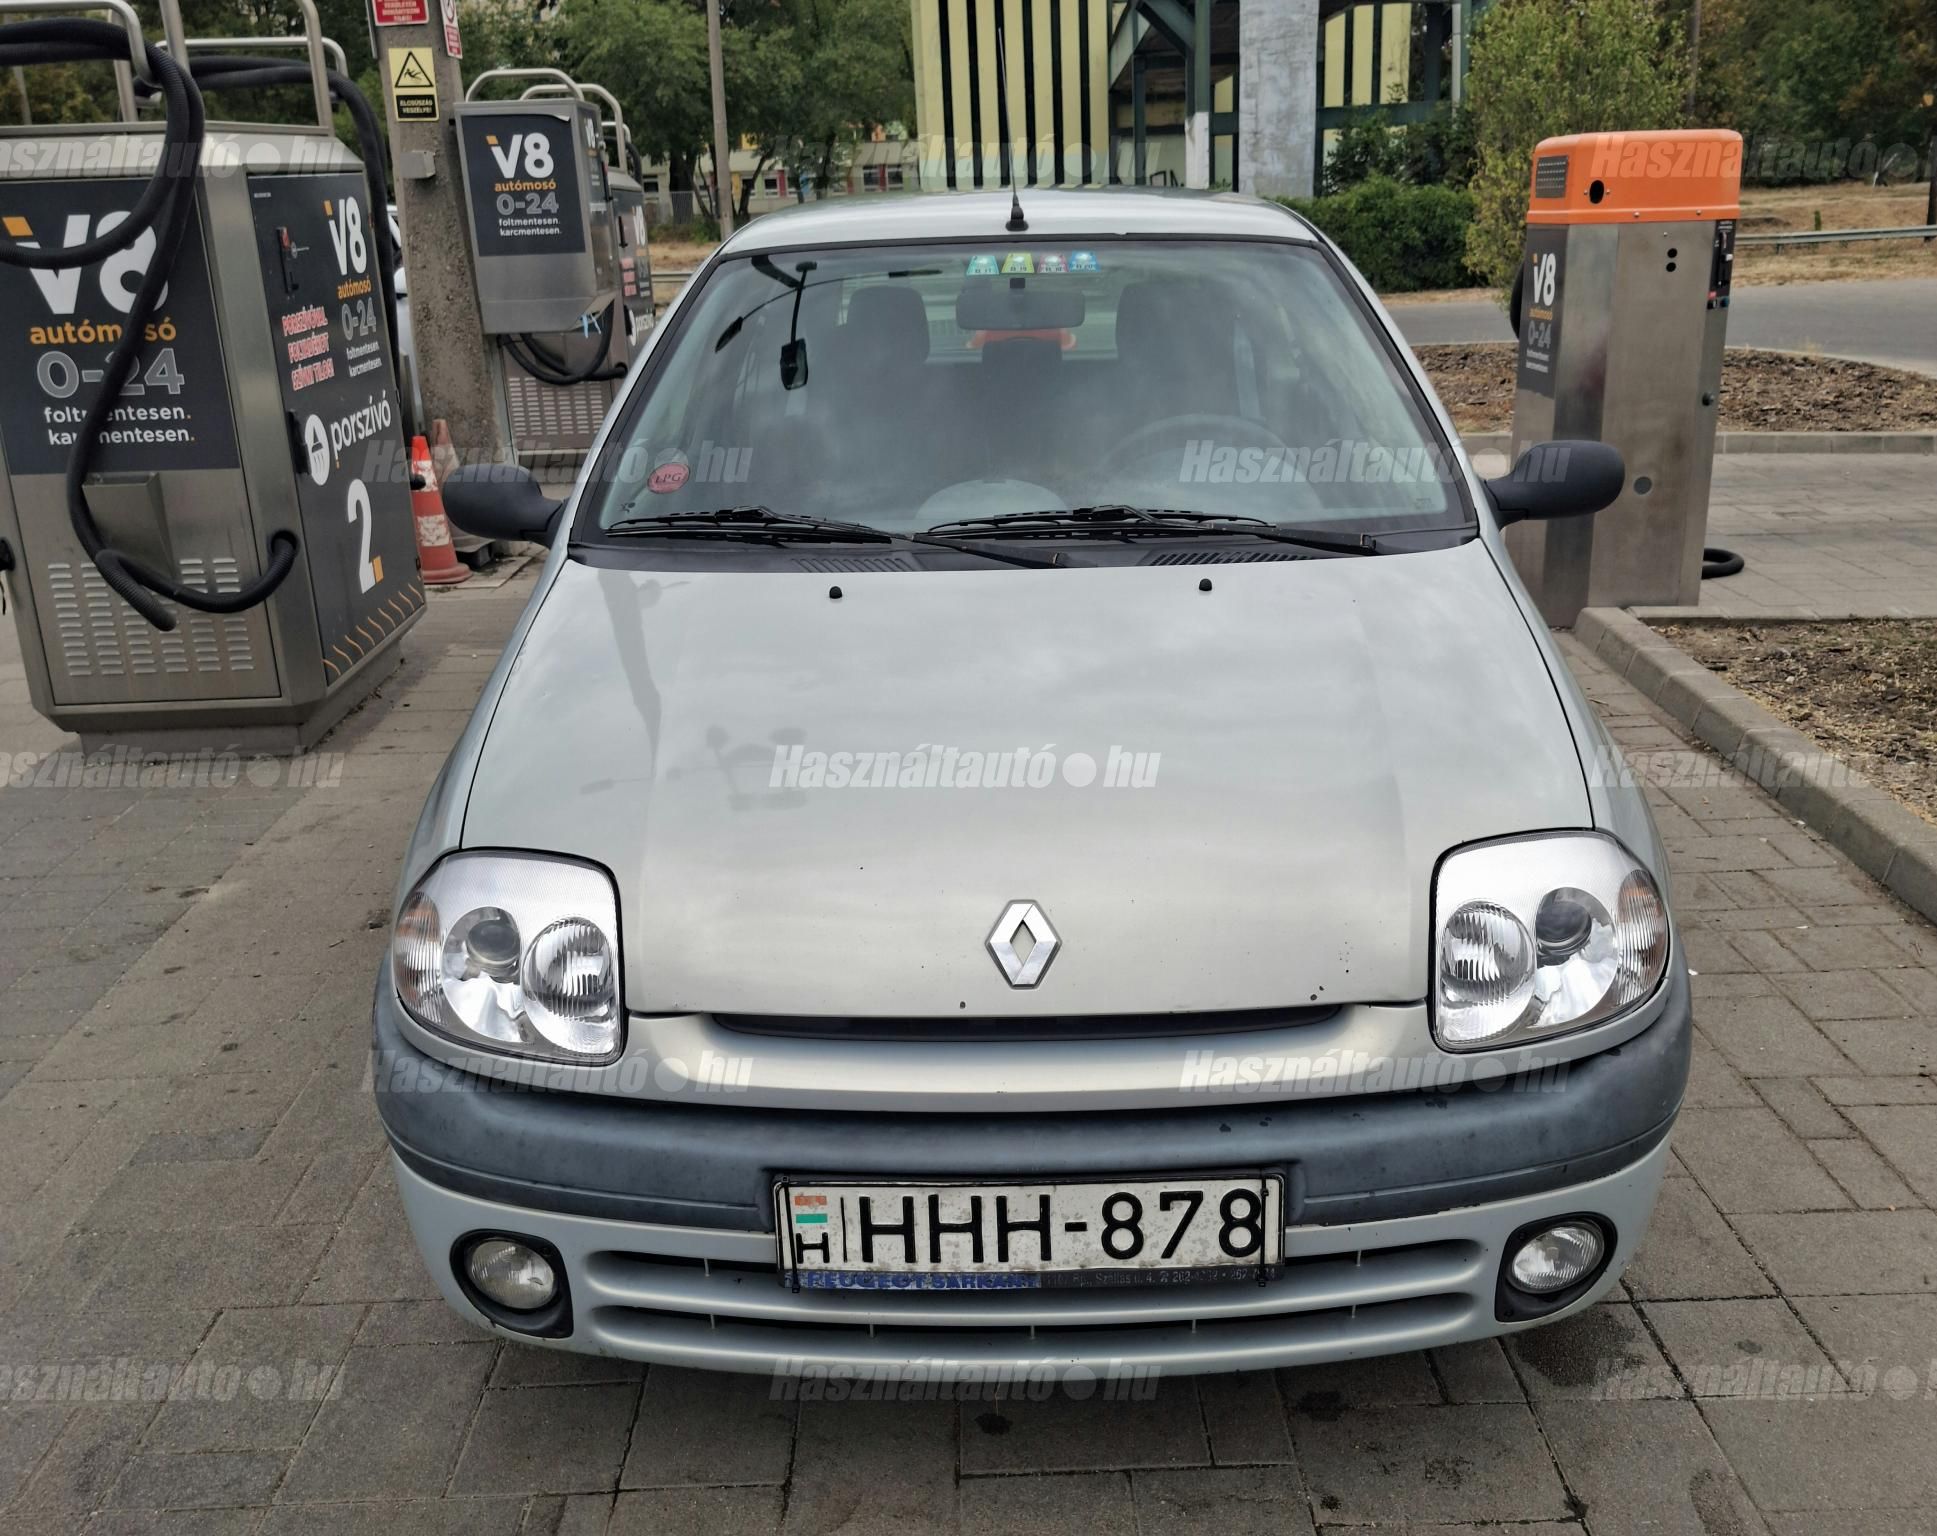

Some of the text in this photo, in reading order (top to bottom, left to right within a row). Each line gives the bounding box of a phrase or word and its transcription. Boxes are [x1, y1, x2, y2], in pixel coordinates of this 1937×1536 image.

[489, 132, 555, 179] V8
[494, 180, 557, 193] autómosó
[496, 193, 559, 217] 0-24
[328, 196, 367, 276] V8
[337, 276, 372, 300] autómosó
[1533, 253, 1557, 306] V8
[30, 318, 177, 345] autómsó
[341, 297, 377, 341] 0-24
[329, 389, 391, 457] porszívó
[655, 472, 683, 484] LPG
[347, 478, 374, 594] 2
[794, 1232, 830, 1264] H
[857, 1188, 1264, 1264] HHH-878
